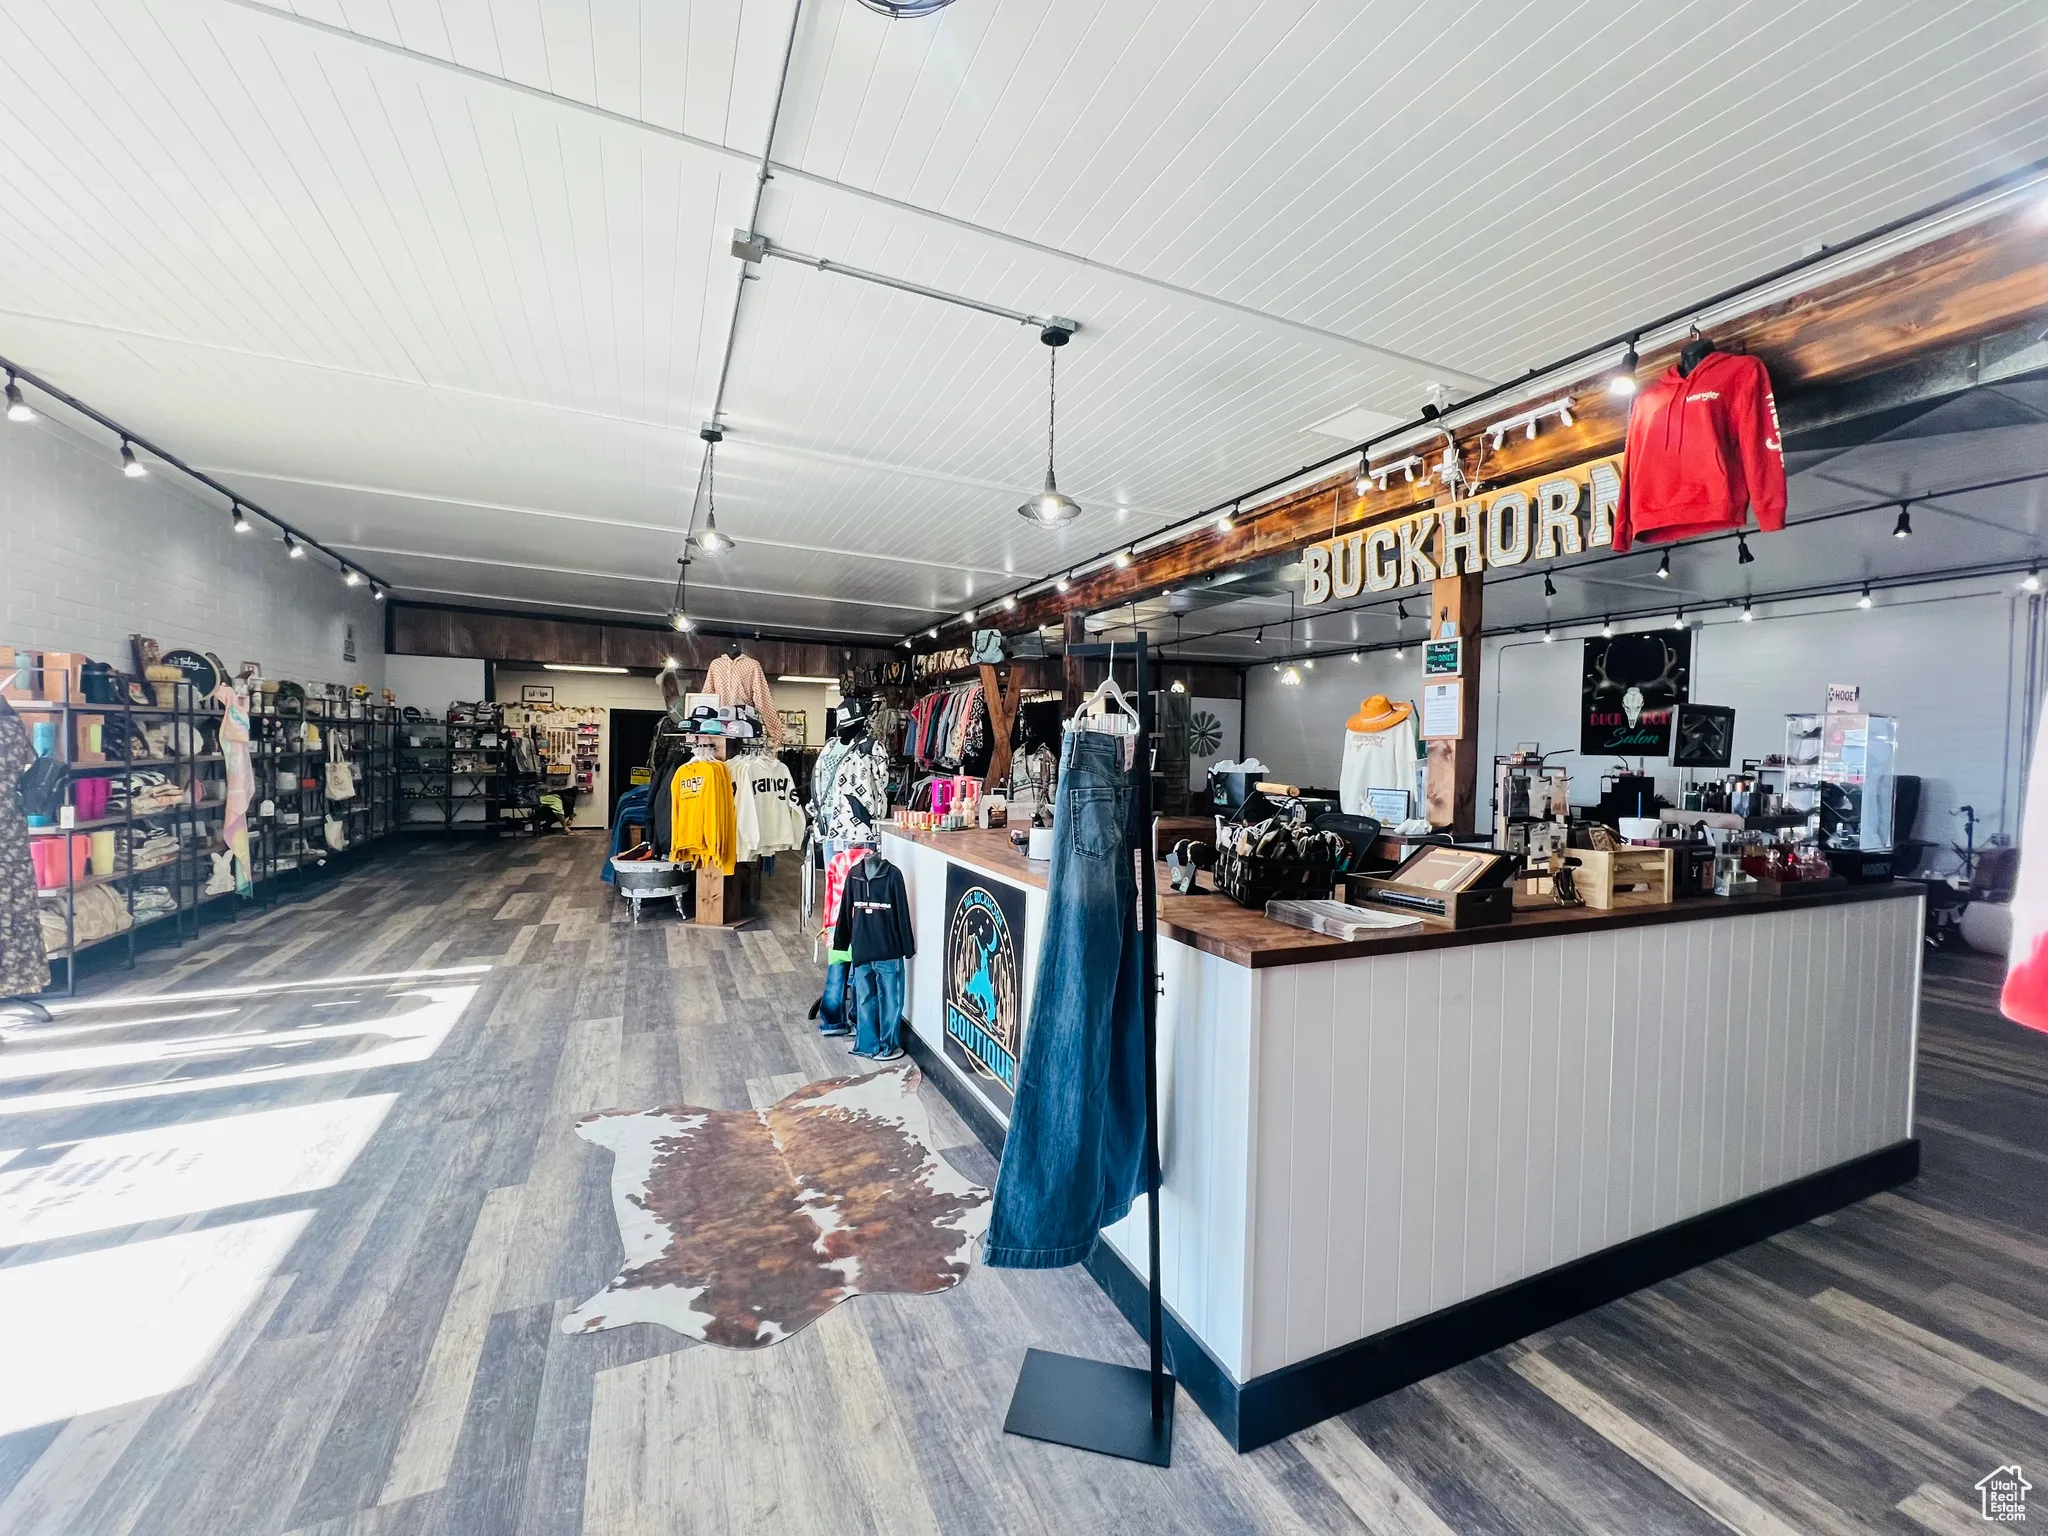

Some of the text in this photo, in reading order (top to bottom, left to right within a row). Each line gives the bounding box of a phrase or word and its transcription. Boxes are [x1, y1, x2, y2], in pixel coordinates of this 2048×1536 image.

[1302, 460, 1622, 606] BUCKHORN
[1603, 727, 1661, 748] Salon
[1641, 710, 1672, 725] HOR
[949, 1006, 1014, 1090] BOUTIQUE
